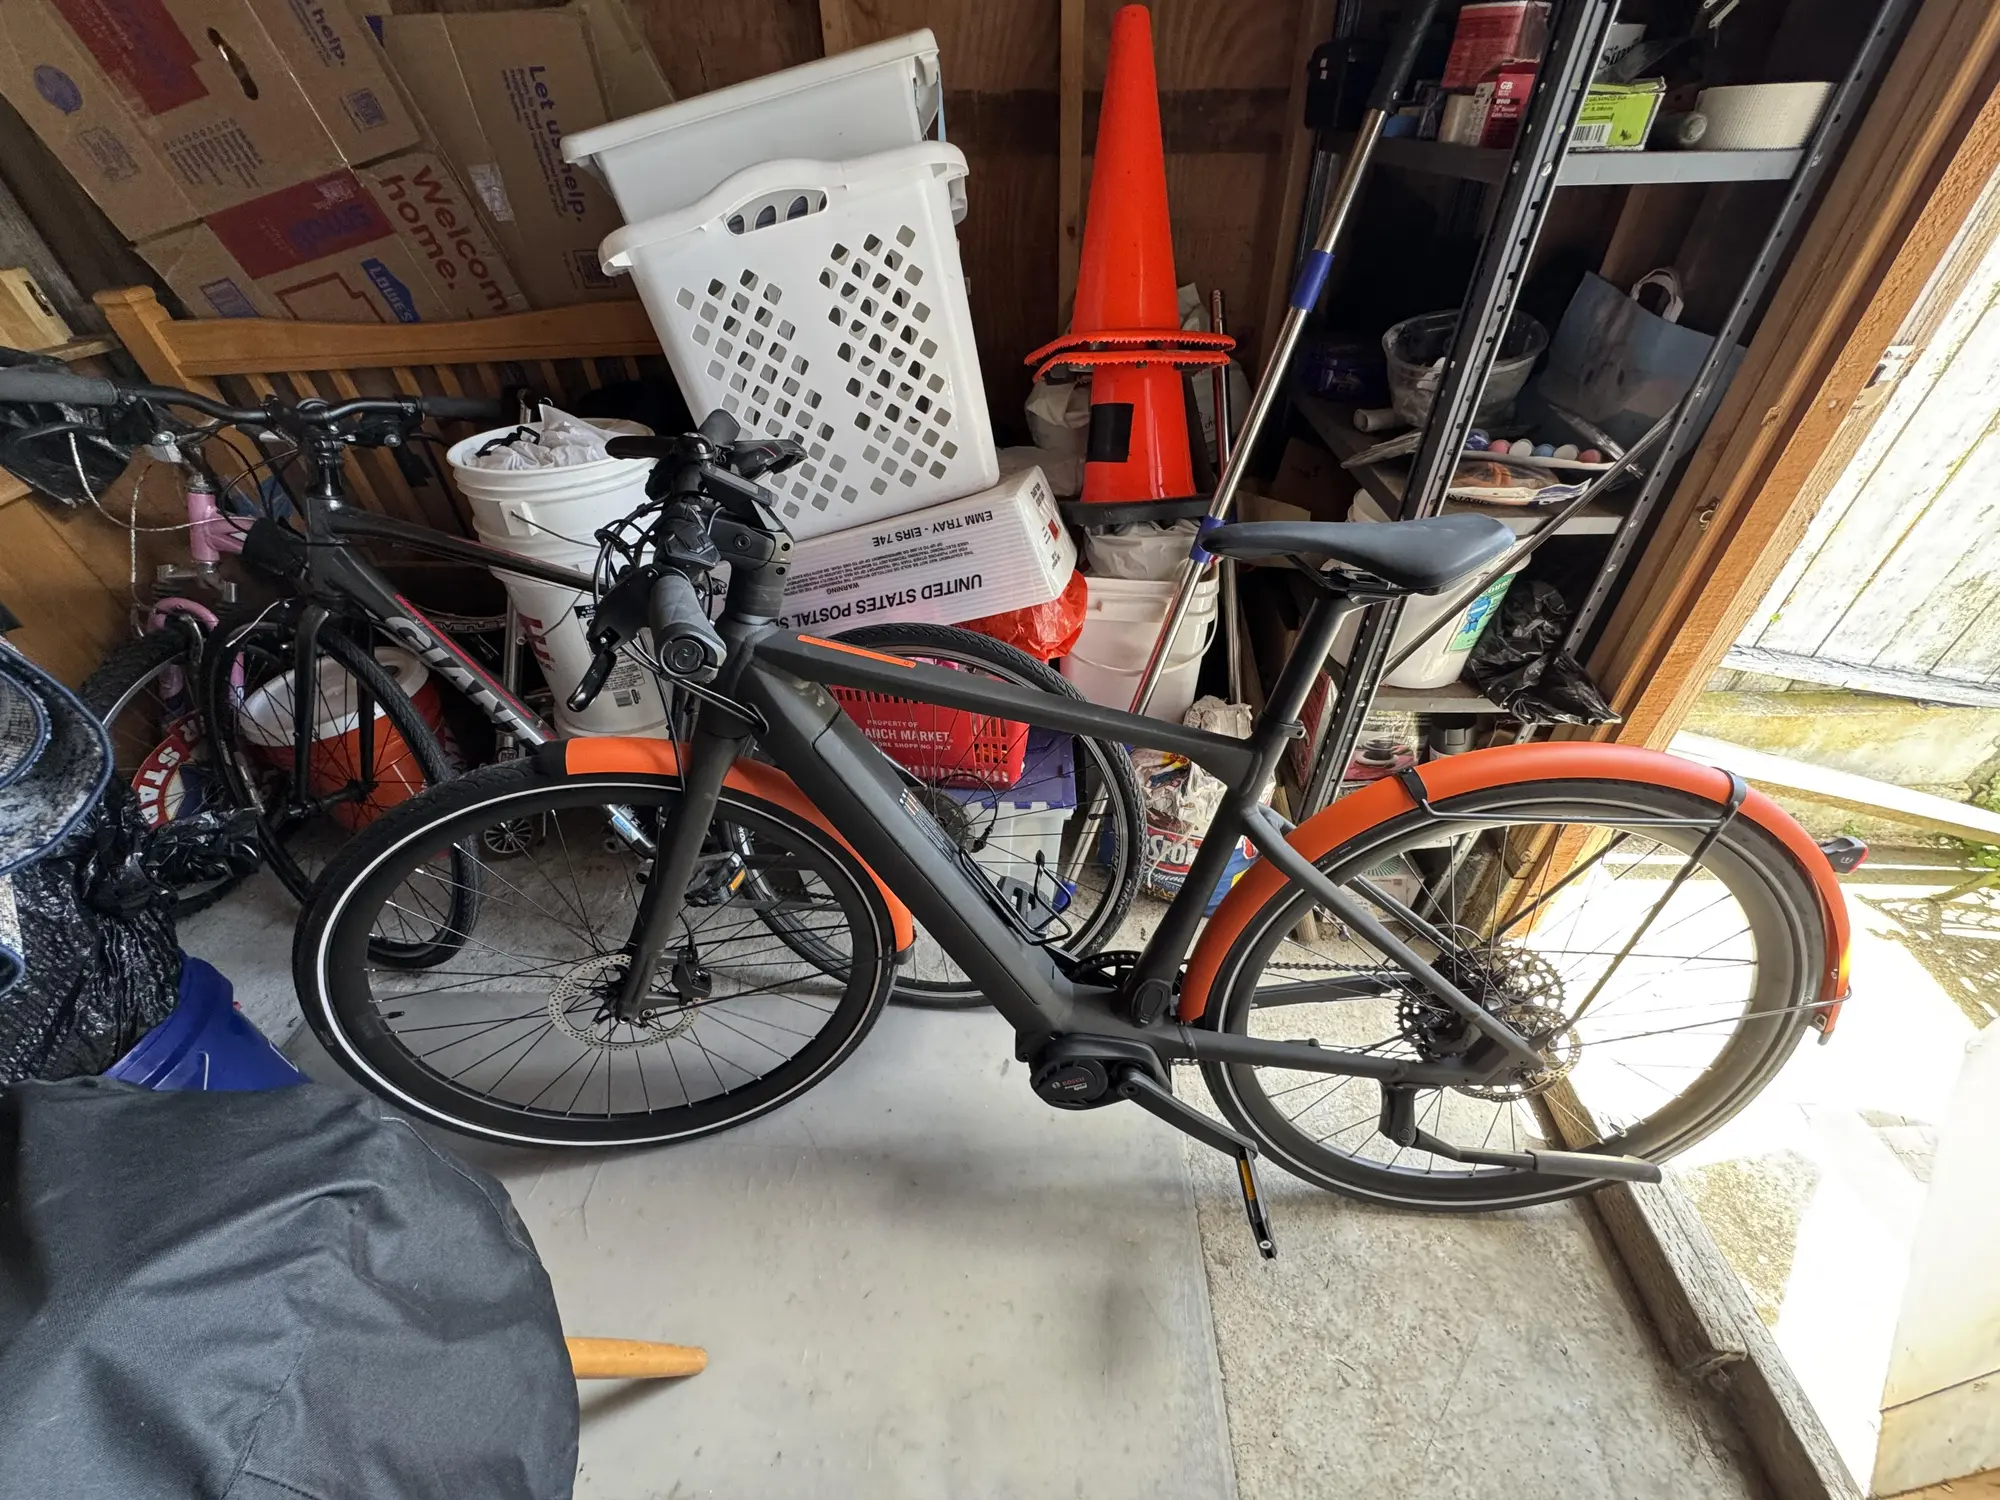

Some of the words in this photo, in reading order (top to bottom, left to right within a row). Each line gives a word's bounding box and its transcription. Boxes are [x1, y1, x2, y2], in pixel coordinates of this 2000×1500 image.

[529, 66, 556, 110] Let
[378, 173, 457, 290] home.
[412, 164, 509, 312] Welcom
[963, 509, 993, 526] EMM
[930, 516, 963, 534] TRAY
[871, 533, 893, 547] 74E
[893, 526, 922, 542] EIRS
[907, 549, 929, 558] TRACKING
[929, 543, 956, 553] ELECTRONIC
[877, 554, 907, 565] TECHNOLOGY
[937, 551, 963, 562] EQUIPMENT
[823, 569, 844, 578] LOCATION
[866, 563, 891, 573] TRANSPORT
[826, 582, 859, 595] WARNING
[921, 574, 982, 599] UNITED
[856, 588, 917, 614] STATES
[792, 603, 852, 628] POSTAL
[385, 616, 545, 746] GIANT
[866, 718, 906, 727] PROPERTY
[900, 729, 950, 743] MARKET
[893, 742, 931, 750] SHOPPNG
